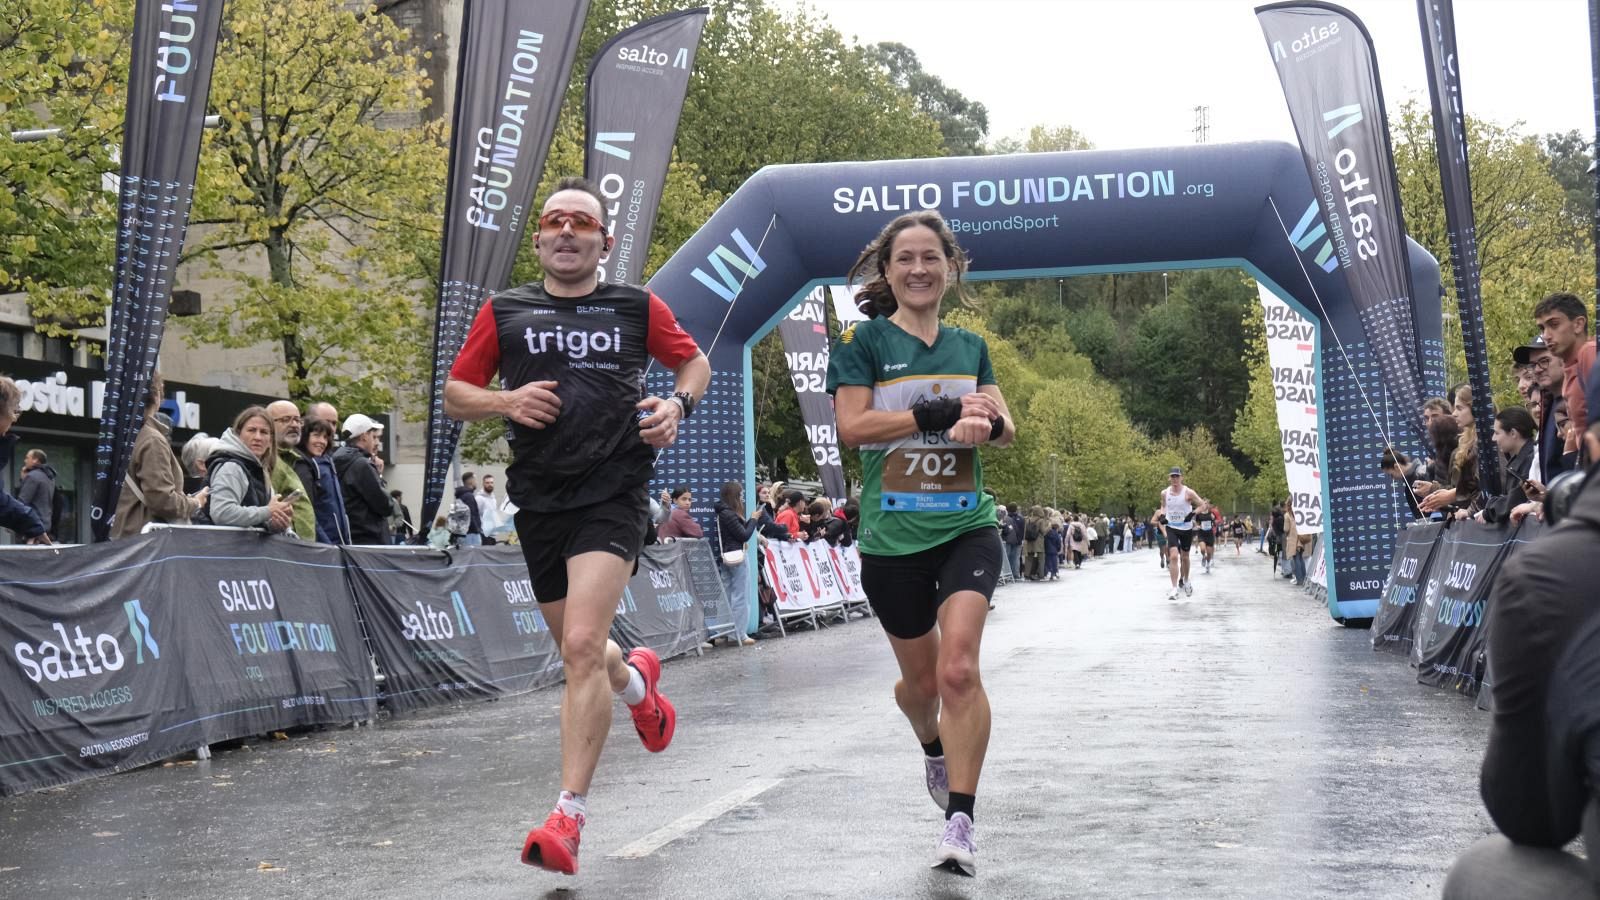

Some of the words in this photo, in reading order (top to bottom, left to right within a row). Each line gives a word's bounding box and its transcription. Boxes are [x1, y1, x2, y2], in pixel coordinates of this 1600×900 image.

[618, 44, 668, 66] salto
[479, 29, 544, 231] FOUNDATION
[833, 183, 941, 214] SALTO
[952, 169, 1175, 208] FOUNDATION
[1182, 183, 1214, 197] .org
[615, 233, 633, 285] NSPIRED
[625, 179, 645, 231] ACCESS
[524, 325, 621, 359] trigoi
[15, 371, 84, 417] ostia
[904, 453, 957, 476] 702
[1397, 557, 1418, 579] ALTO
[218, 579, 275, 612] SALTO
[1350, 580, 1379, 591] SALTO
[402, 600, 453, 640] salto
[15, 622, 125, 683] salto
[229, 620, 337, 655] FOUNDATION
[89, 685, 133, 709] ACCESS
[80, 744, 104, 758] SALTO
